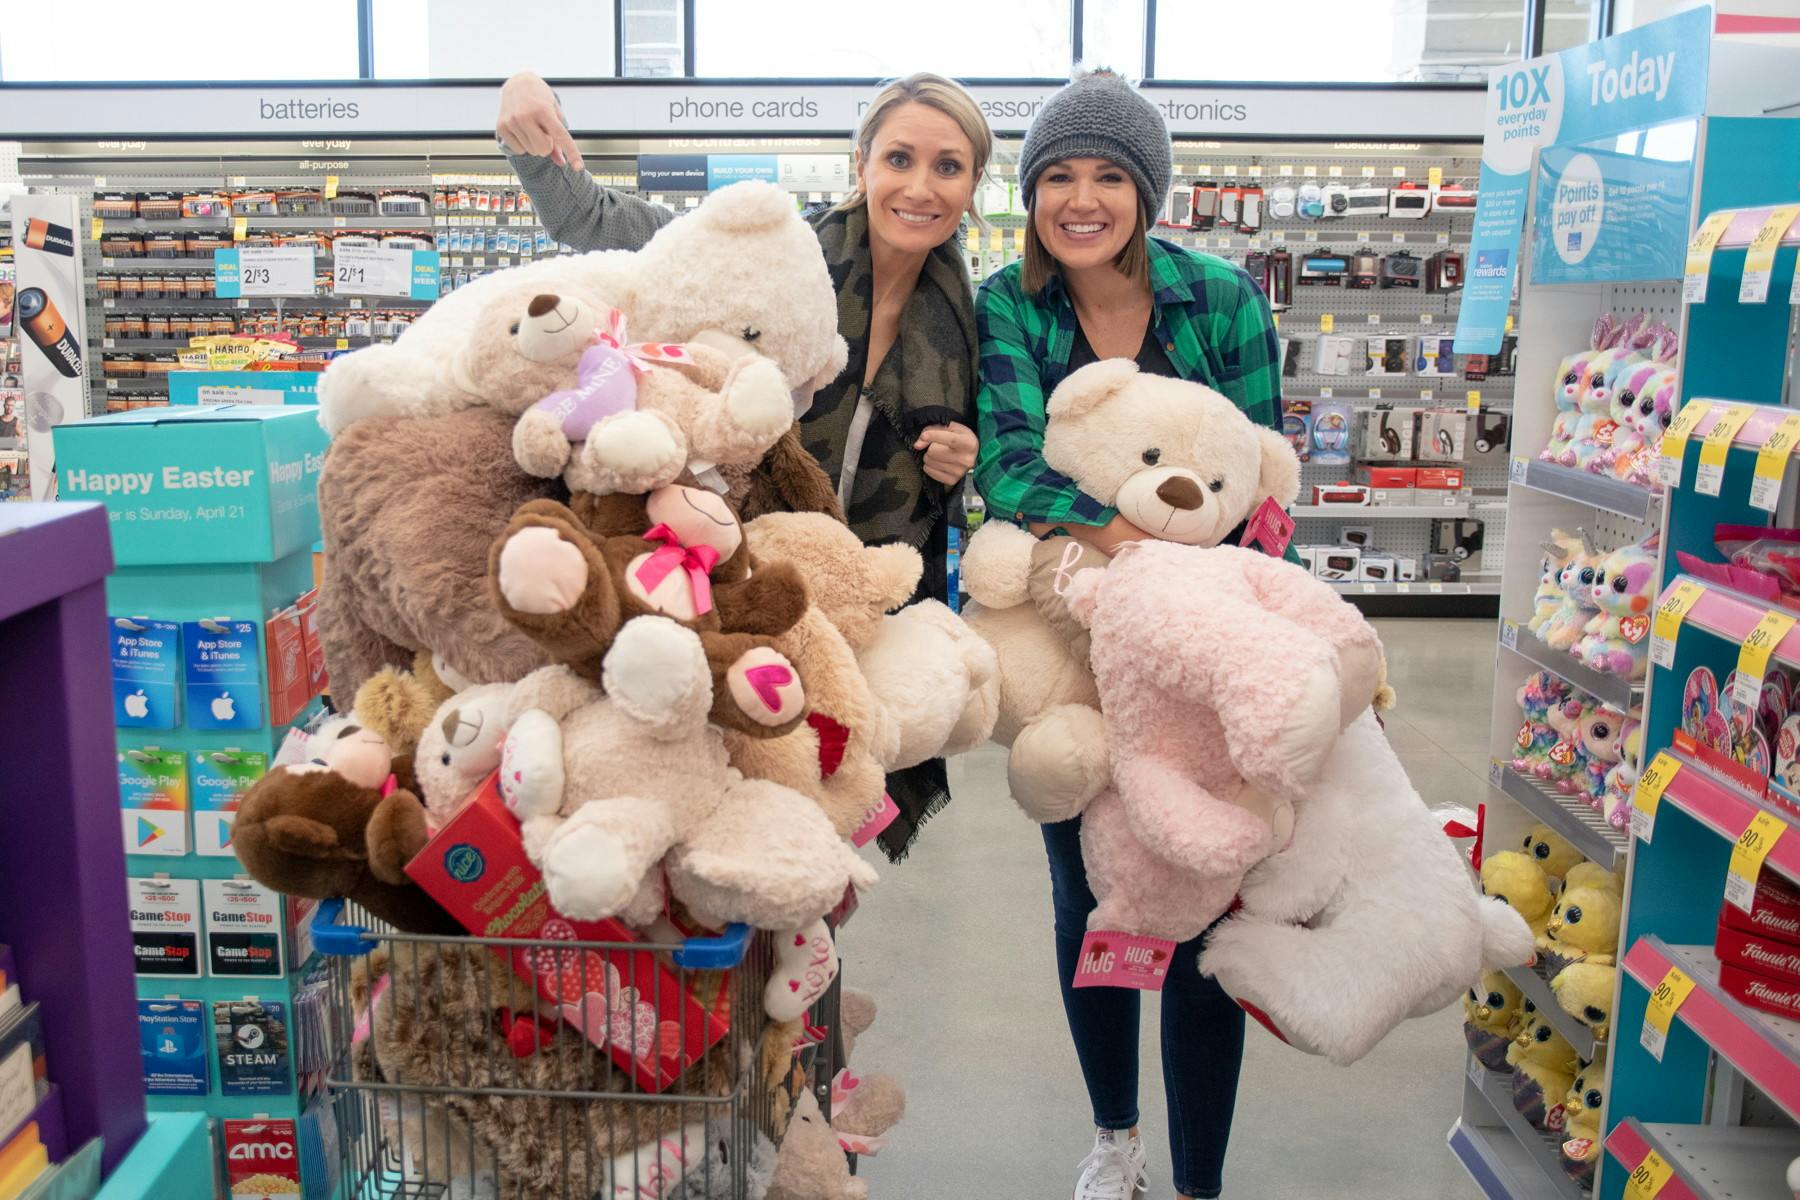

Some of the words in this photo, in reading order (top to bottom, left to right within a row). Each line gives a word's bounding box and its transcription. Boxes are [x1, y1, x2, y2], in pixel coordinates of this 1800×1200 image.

[1587, 51, 1675, 105] Today
[1496, 65, 1551, 110] 10X
[259, 97, 360, 120] batteries
[669, 97, 744, 123] phone
[752, 97, 818, 118] cards
[982, 97, 1043, 117] essori
[1497, 108, 1548, 127] everyday
[1503, 125, 1541, 142] points
[299, 160, 349, 171] all-purpose
[640, 169, 657, 178] bring
[684, 169, 705, 177] device
[1559, 181, 1600, 204] Points
[1557, 209, 1578, 230] pay
[1579, 205, 1596, 223] off
[1473, 266, 1507, 278] rewards
[215, 344, 250, 354] HARIBO
[576, 356, 621, 401] MINE
[67, 468, 153, 495] Happy
[162, 465, 255, 489] Easter
[270, 460, 303, 484] Happy
[125, 508, 137, 520] is
[140, 506, 193, 521] Sunday,
[196, 505, 225, 521] April
[229, 506, 245, 517] 21
[1265, 508, 1282, 535] HUG
[1662, 597, 1681, 613] 90
[1620, 620, 1643, 640] ty
[1746, 629, 1767, 647] 90
[118, 636, 137, 646] App
[139, 637, 163, 648] Store
[198, 640, 217, 651] App
[218, 640, 242, 648] Store
[121, 648, 128, 656] &
[130, 648, 160, 659] iTunes
[201, 652, 208, 660] &
[210, 651, 240, 660] iTunes
[120, 773, 158, 789] Google
[159, 775, 181, 790] Play
[197, 775, 238, 789] Google
[1641, 769, 1659, 786] 90
[1739, 829, 1759, 848] 90
[130, 909, 192, 923] GameStop
[213, 911, 273, 924] GameStop
[1751, 908, 1799, 932] Fannie
[134, 945, 190, 957] GameStop
[216, 946, 272, 958] GameStop
[1125, 946, 1155, 965] HUG
[1741, 943, 1788, 967] Fannie
[1081, 951, 1116, 974] HUG
[1654, 982, 1671, 1001] 90
[1744, 981, 1792, 1004] Fannie
[140, 1015, 179, 1024] PlayStation
[180, 1015, 197, 1023] Store
[226, 1054, 277, 1065] STEAM
[1632, 1165, 1650, 1184] 90
